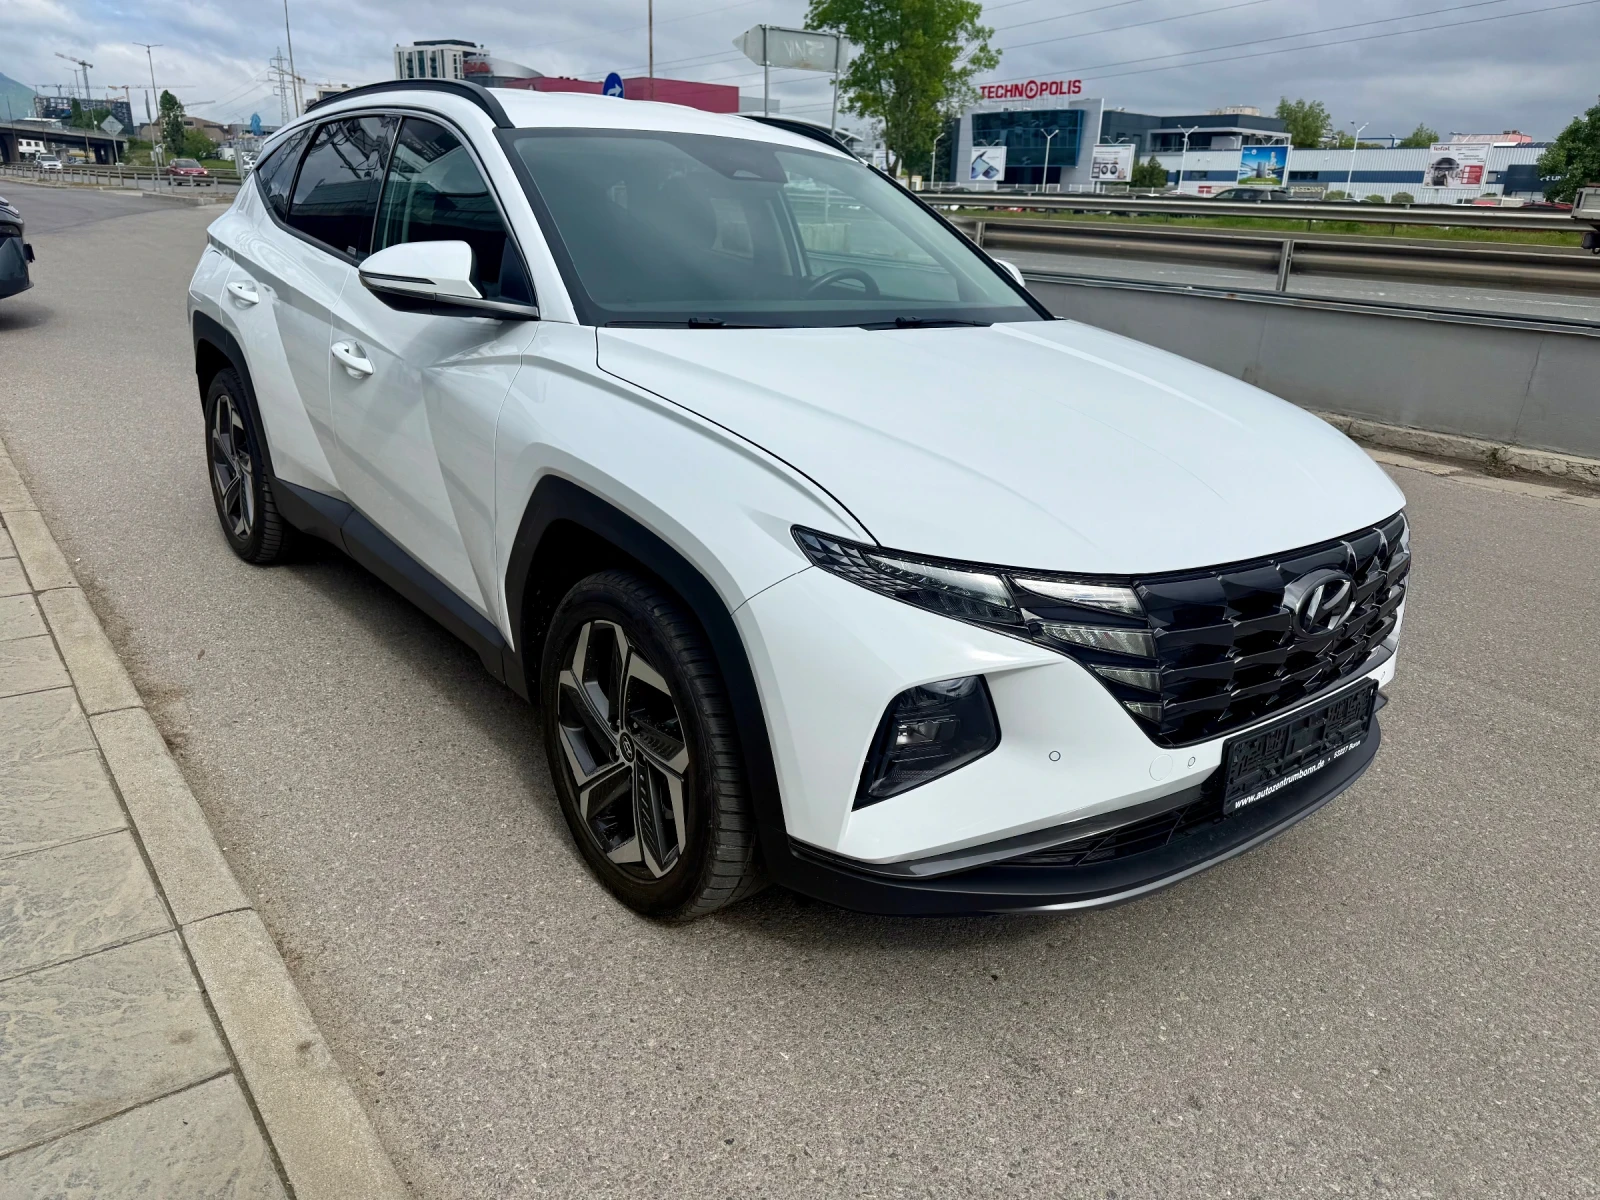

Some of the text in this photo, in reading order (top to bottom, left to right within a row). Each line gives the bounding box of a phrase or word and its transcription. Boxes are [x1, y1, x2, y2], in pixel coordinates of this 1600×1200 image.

[980, 79, 1082, 99] TECHNOPOLIS
[1234, 759, 1325, 809] www.autozentrumbonn.de
[1348, 740, 1361, 751] Bonn
